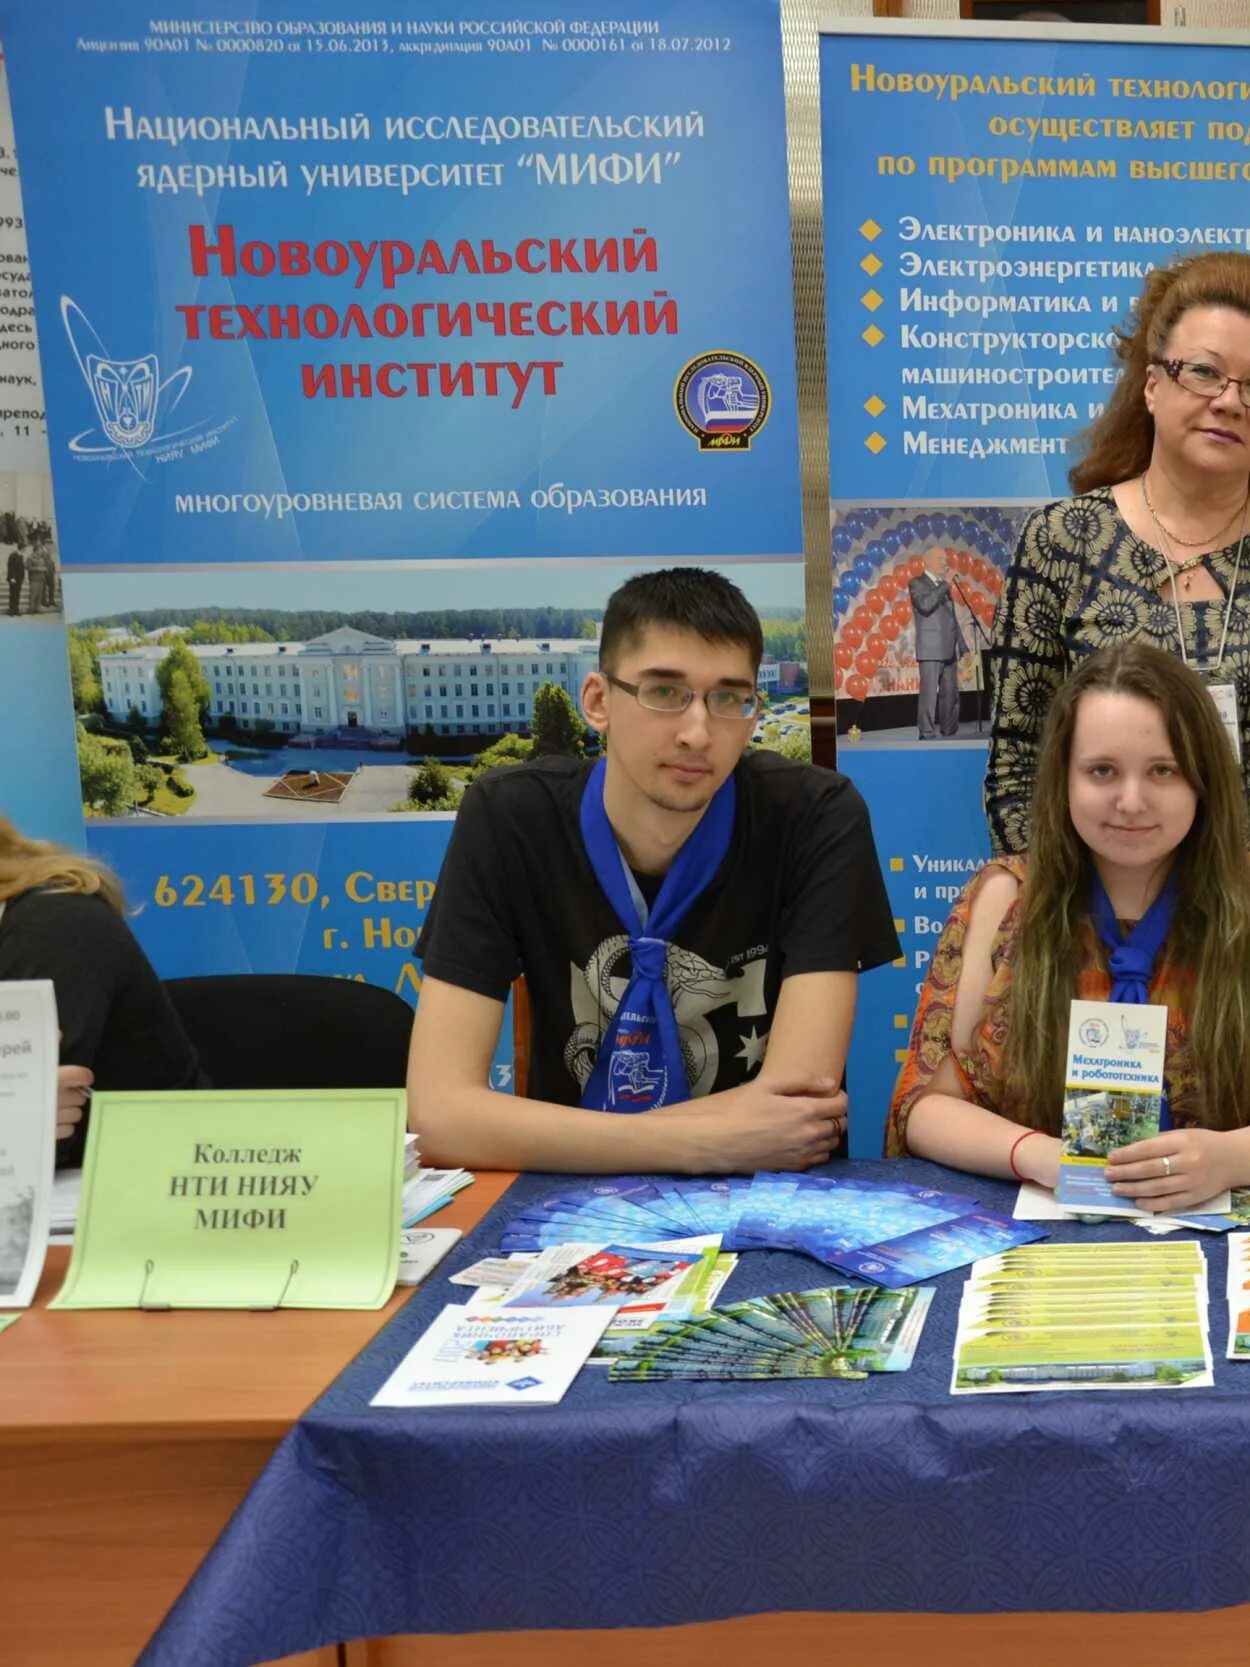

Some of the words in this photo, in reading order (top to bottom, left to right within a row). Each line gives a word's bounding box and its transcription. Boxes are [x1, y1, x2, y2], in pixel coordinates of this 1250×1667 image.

[149, 20, 273, 35] МИНИСТЕРСТВО
[276, 20, 387, 35] ОБРАЗОВАНИЯ
[392, 20, 401, 35] И
[406, 20, 455, 35] НАУКИ
[459, 17, 565, 35] РОССИЙСКОЙ
[569, 20, 660, 37] ФЕДЕРАЦИИ
[216, 38, 284, 52] 0000820
[562, 37, 625, 51] 0000161
[650, 37, 732, 51] 18.07.2012
[850, 62, 1097, 101] Новоуральский
[104, 106, 371, 145] Национальный
[385, 110, 705, 142] исследовательский
[988, 116, 1195, 143] осуществляет
[136, 156, 288, 196] ядерный
[300, 162, 504, 196] университет
[877, 155, 916, 176] по
[928, 156, 1118, 185] программам
[898, 216, 1076, 247] Электроника
[1086, 226, 1103, 242] и
[187, 225, 660, 289] Новоуральский
[175, 291, 680, 342] технологический
[900, 287, 1092, 319] Информатика
[1101, 296, 1118, 313] и
[900, 324, 1120, 355] Конструкторско
[300, 359, 565, 410] институт
[902, 395, 1079, 425] Мехатроника
[1089, 401, 1104, 418] и
[903, 430, 1071, 459] Менеджмент
[175, 492, 404, 518] многоуровневая
[413, 488, 521, 512] система
[530, 482, 708, 513] образования
[154, 872, 331, 911] 624130,
[914, 886, 928, 899] и
[323, 928, 349, 950] г.
[1072, 1053, 1142, 1069] Мехатроника
[1081, 1068, 1160, 1083] робототехника
[193, 1143, 302, 1168] Колледж
[168, 1176, 230, 1198] НТИ
[236, 1174, 320, 1197] НИЯУ
[194, 1208, 287, 1230] МИФИ
